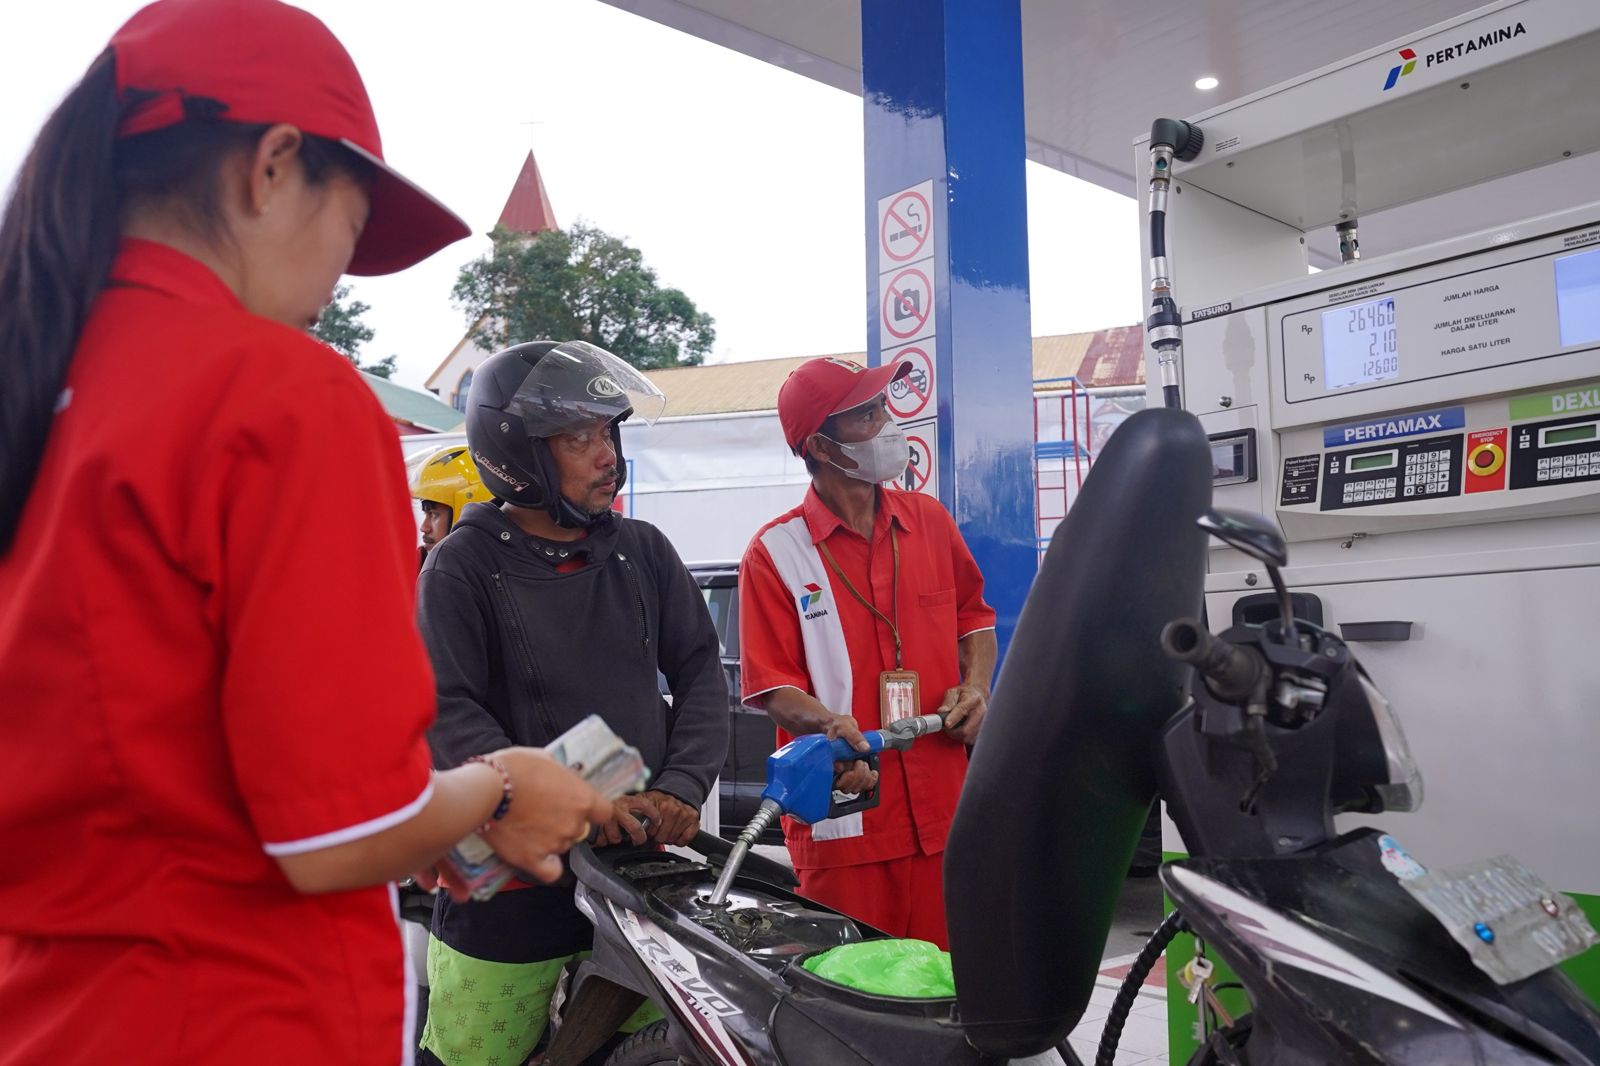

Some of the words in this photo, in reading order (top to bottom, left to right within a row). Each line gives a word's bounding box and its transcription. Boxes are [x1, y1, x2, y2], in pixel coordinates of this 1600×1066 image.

[1426, 22, 1526, 68] PERTAMINA
[1443, 291, 1472, 302] JUMLAH
[1473, 284, 1500, 295] HARGA
[1193, 303, 1230, 319] TATSUNO
[1348, 300, 1395, 333] 26460
[1434, 318, 1462, 330] JUMLAH
[1464, 307, 1516, 324] DIKELUARKAN
[1301, 324, 1313, 335] Rp
[1450, 322, 1475, 333] DALAM
[1478, 318, 1498, 327] LITER
[1369, 328, 1397, 357] 2.10
[1441, 346, 1466, 356] HARGA
[1468, 342, 1487, 351] SATU
[1489, 337, 1511, 347] LITER
[1363, 356, 1398, 377] 12600
[892, 380, 908, 392] ON
[1304, 373, 1316, 384] Rp
[1344, 414, 1442, 442] PERTAMAX
[1471, 429, 1504, 439] EMERGENCY
[635, 935, 740, 1014] REVO
